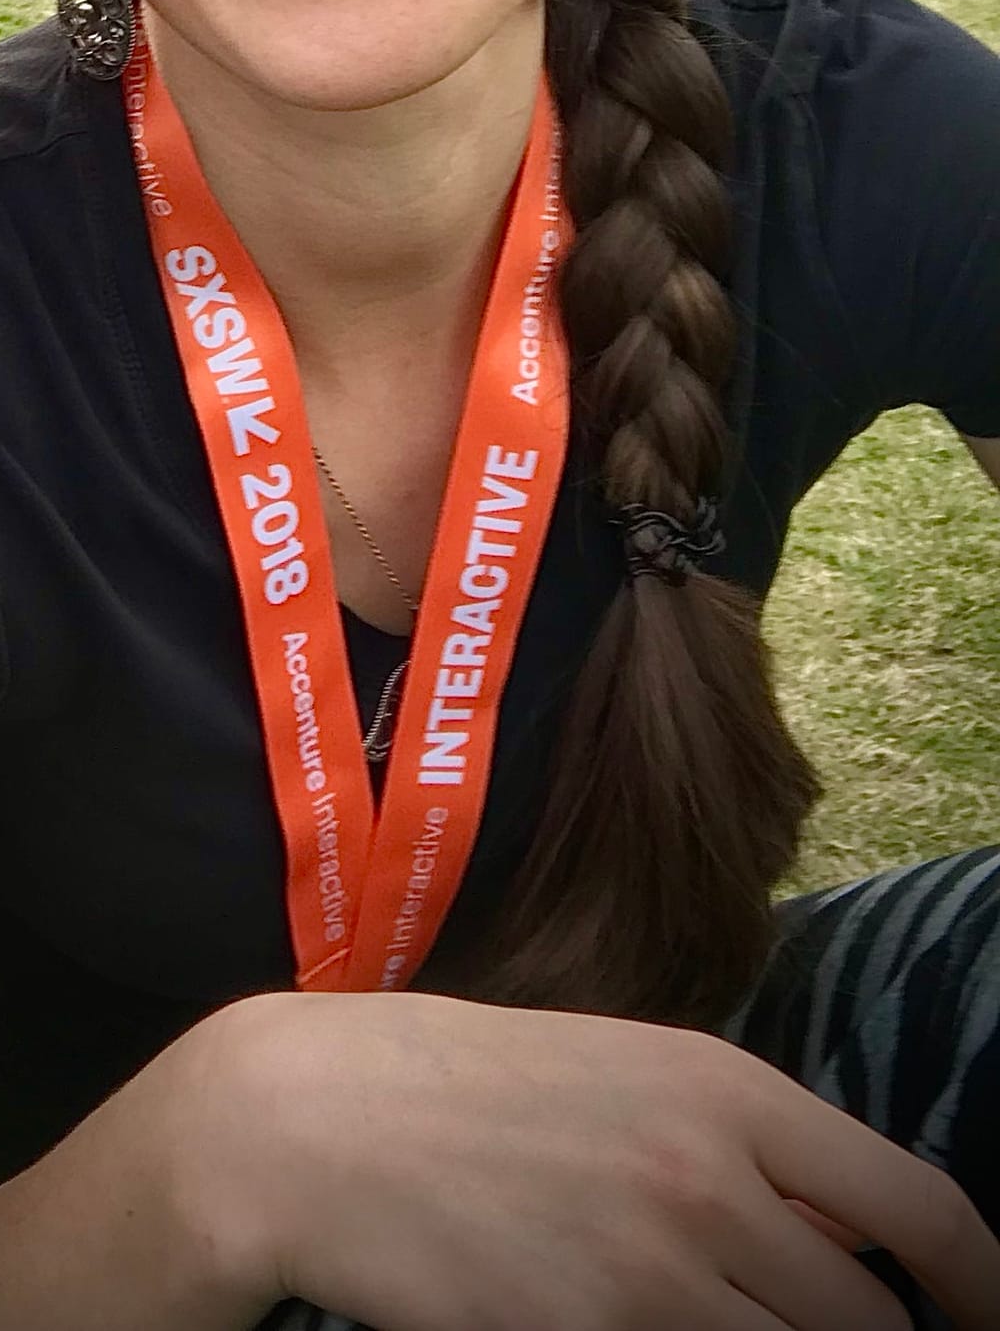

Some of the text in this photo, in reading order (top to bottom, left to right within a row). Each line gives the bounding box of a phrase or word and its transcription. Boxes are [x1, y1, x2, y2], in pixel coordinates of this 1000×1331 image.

[511, 230, 561, 405] Accenture
[239, 463, 310, 605] 2018
[417, 444, 540, 786] INTERACTIVE
[282, 632, 346, 943] Accenture Interactive
[386, 806, 449, 950] Interactive
